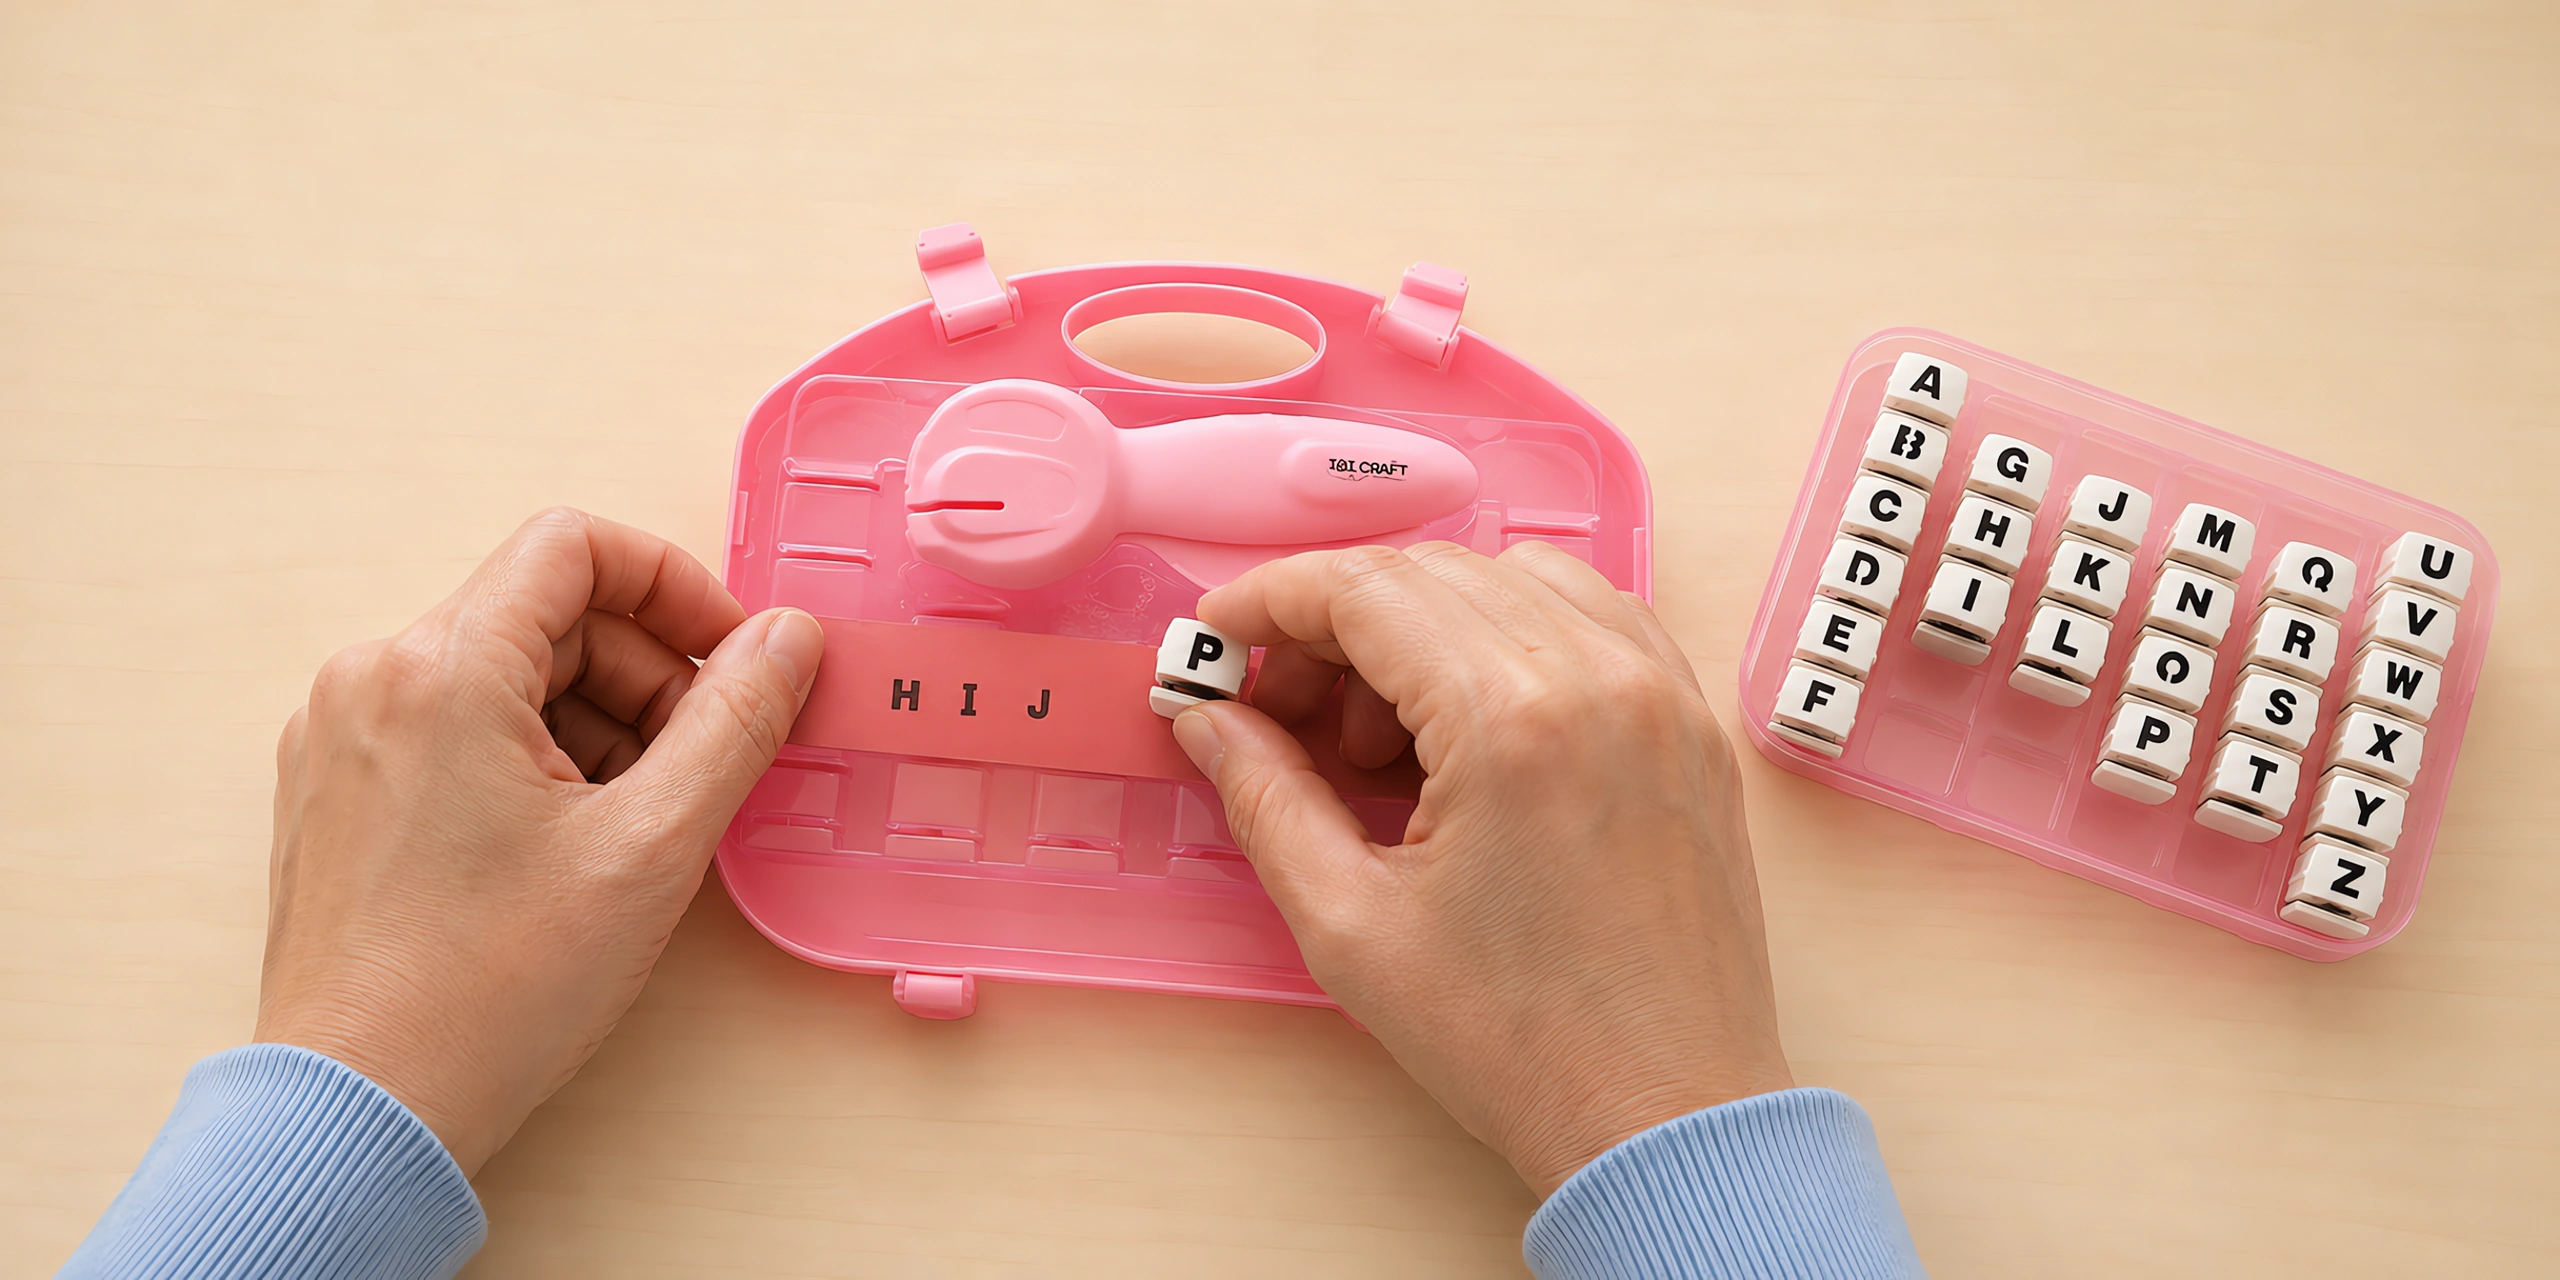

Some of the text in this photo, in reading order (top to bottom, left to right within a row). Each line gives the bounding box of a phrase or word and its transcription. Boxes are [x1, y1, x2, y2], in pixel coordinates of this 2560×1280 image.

[1910, 365, 1940, 400] A
[1891, 425, 1925, 459] B
[1359, 461, 1408, 475] CRAFT
[1997, 448, 2028, 482] G
[1870, 490, 1901, 522] C
[2099, 492, 2128, 521] J
[1975, 509, 2010, 547] H
[2197, 514, 2235, 553] M
[1846, 550, 1879, 585] D
[2074, 553, 2110, 591] K
[2302, 557, 2333, 592] Q
[2421, 544, 2454, 579] U
[1962, 579, 1981, 611] I
[2176, 582, 2213, 618] N
[1823, 615, 1856, 652] E
[2408, 602, 2437, 636] V
[1187, 632, 1223, 670] P
[2052, 619, 2078, 658] L
[2282, 620, 2315, 659] R
[2157, 652, 2189, 683] O
[2387, 661, 2423, 700] W
[891, 679, 1050, 719] H I J
[1803, 680, 1835, 712] F
[2266, 689, 2296, 725] S
[2136, 716, 2170, 749] P
[2366, 724, 2402, 763] X
[2250, 755, 2278, 793] T
[2355, 790, 2385, 826] Y
[2331, 859, 2366, 899] Z
